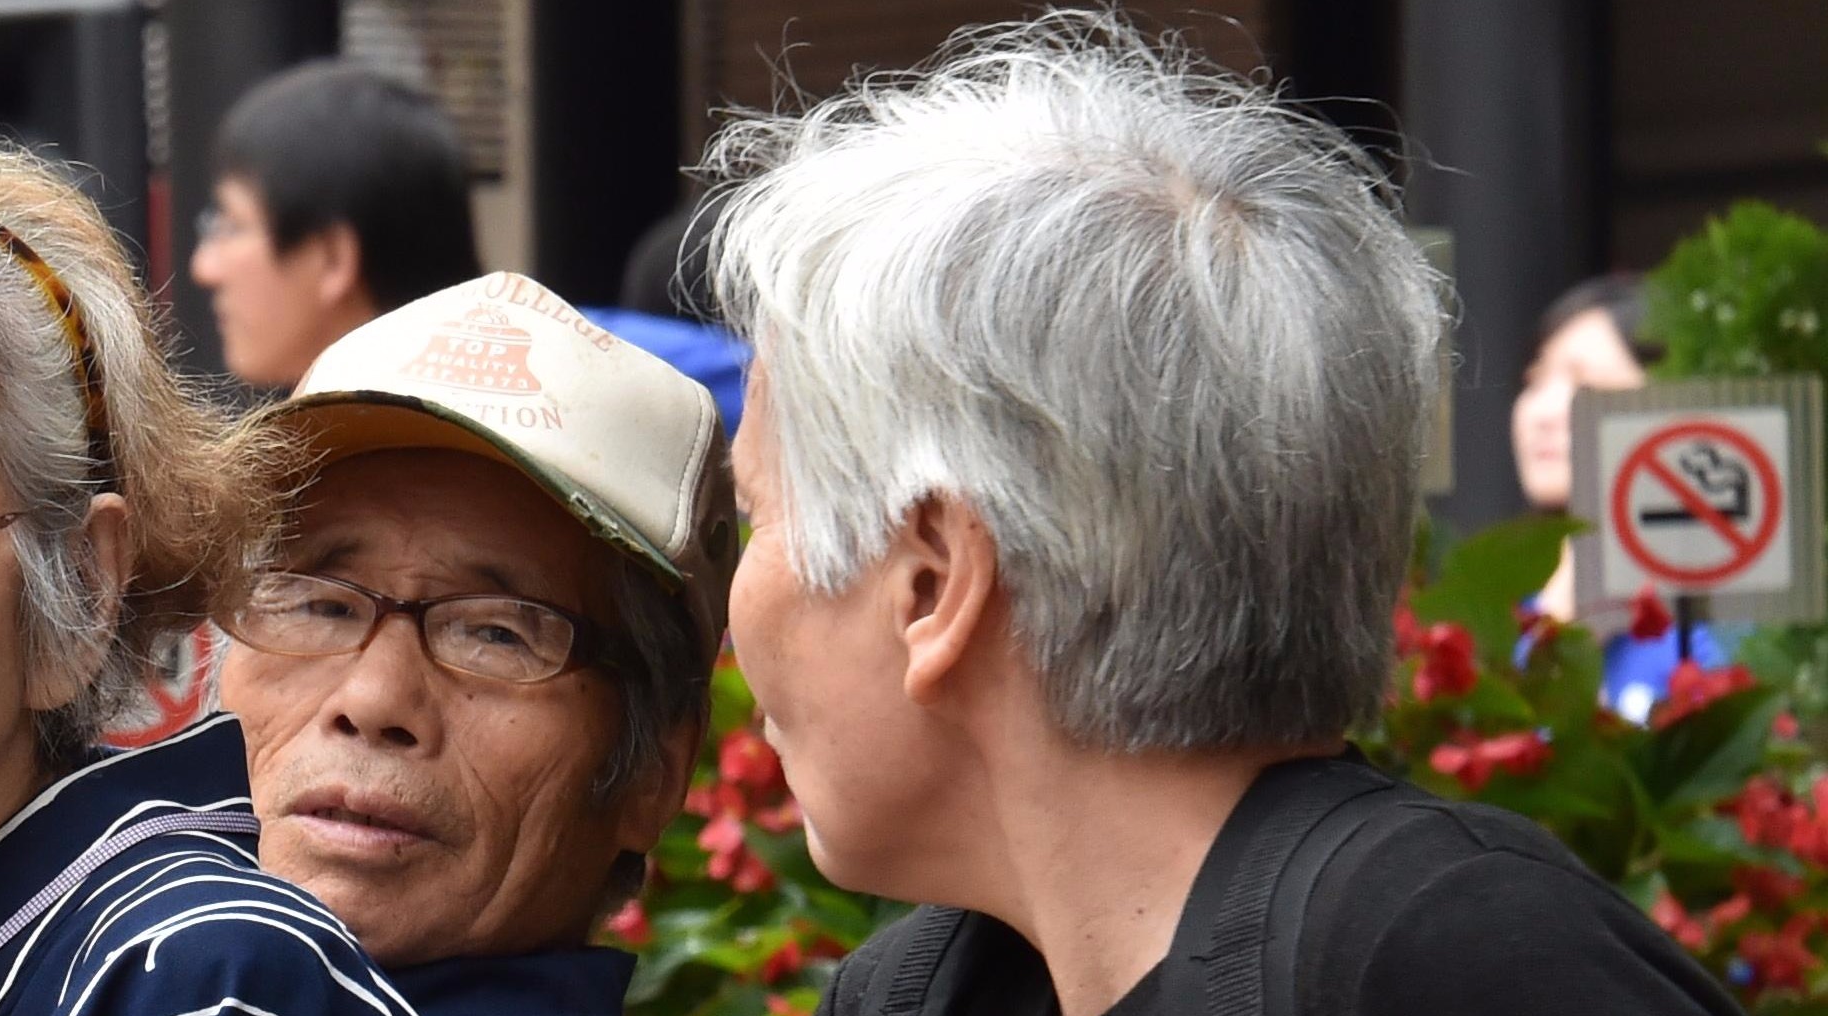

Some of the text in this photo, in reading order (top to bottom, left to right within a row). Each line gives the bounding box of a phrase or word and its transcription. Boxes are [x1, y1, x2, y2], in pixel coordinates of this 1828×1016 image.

[462, 272, 614, 352] OLLEGE
[447, 337, 508, 357] TOP
[427, 352, 518, 374] QUALITY
